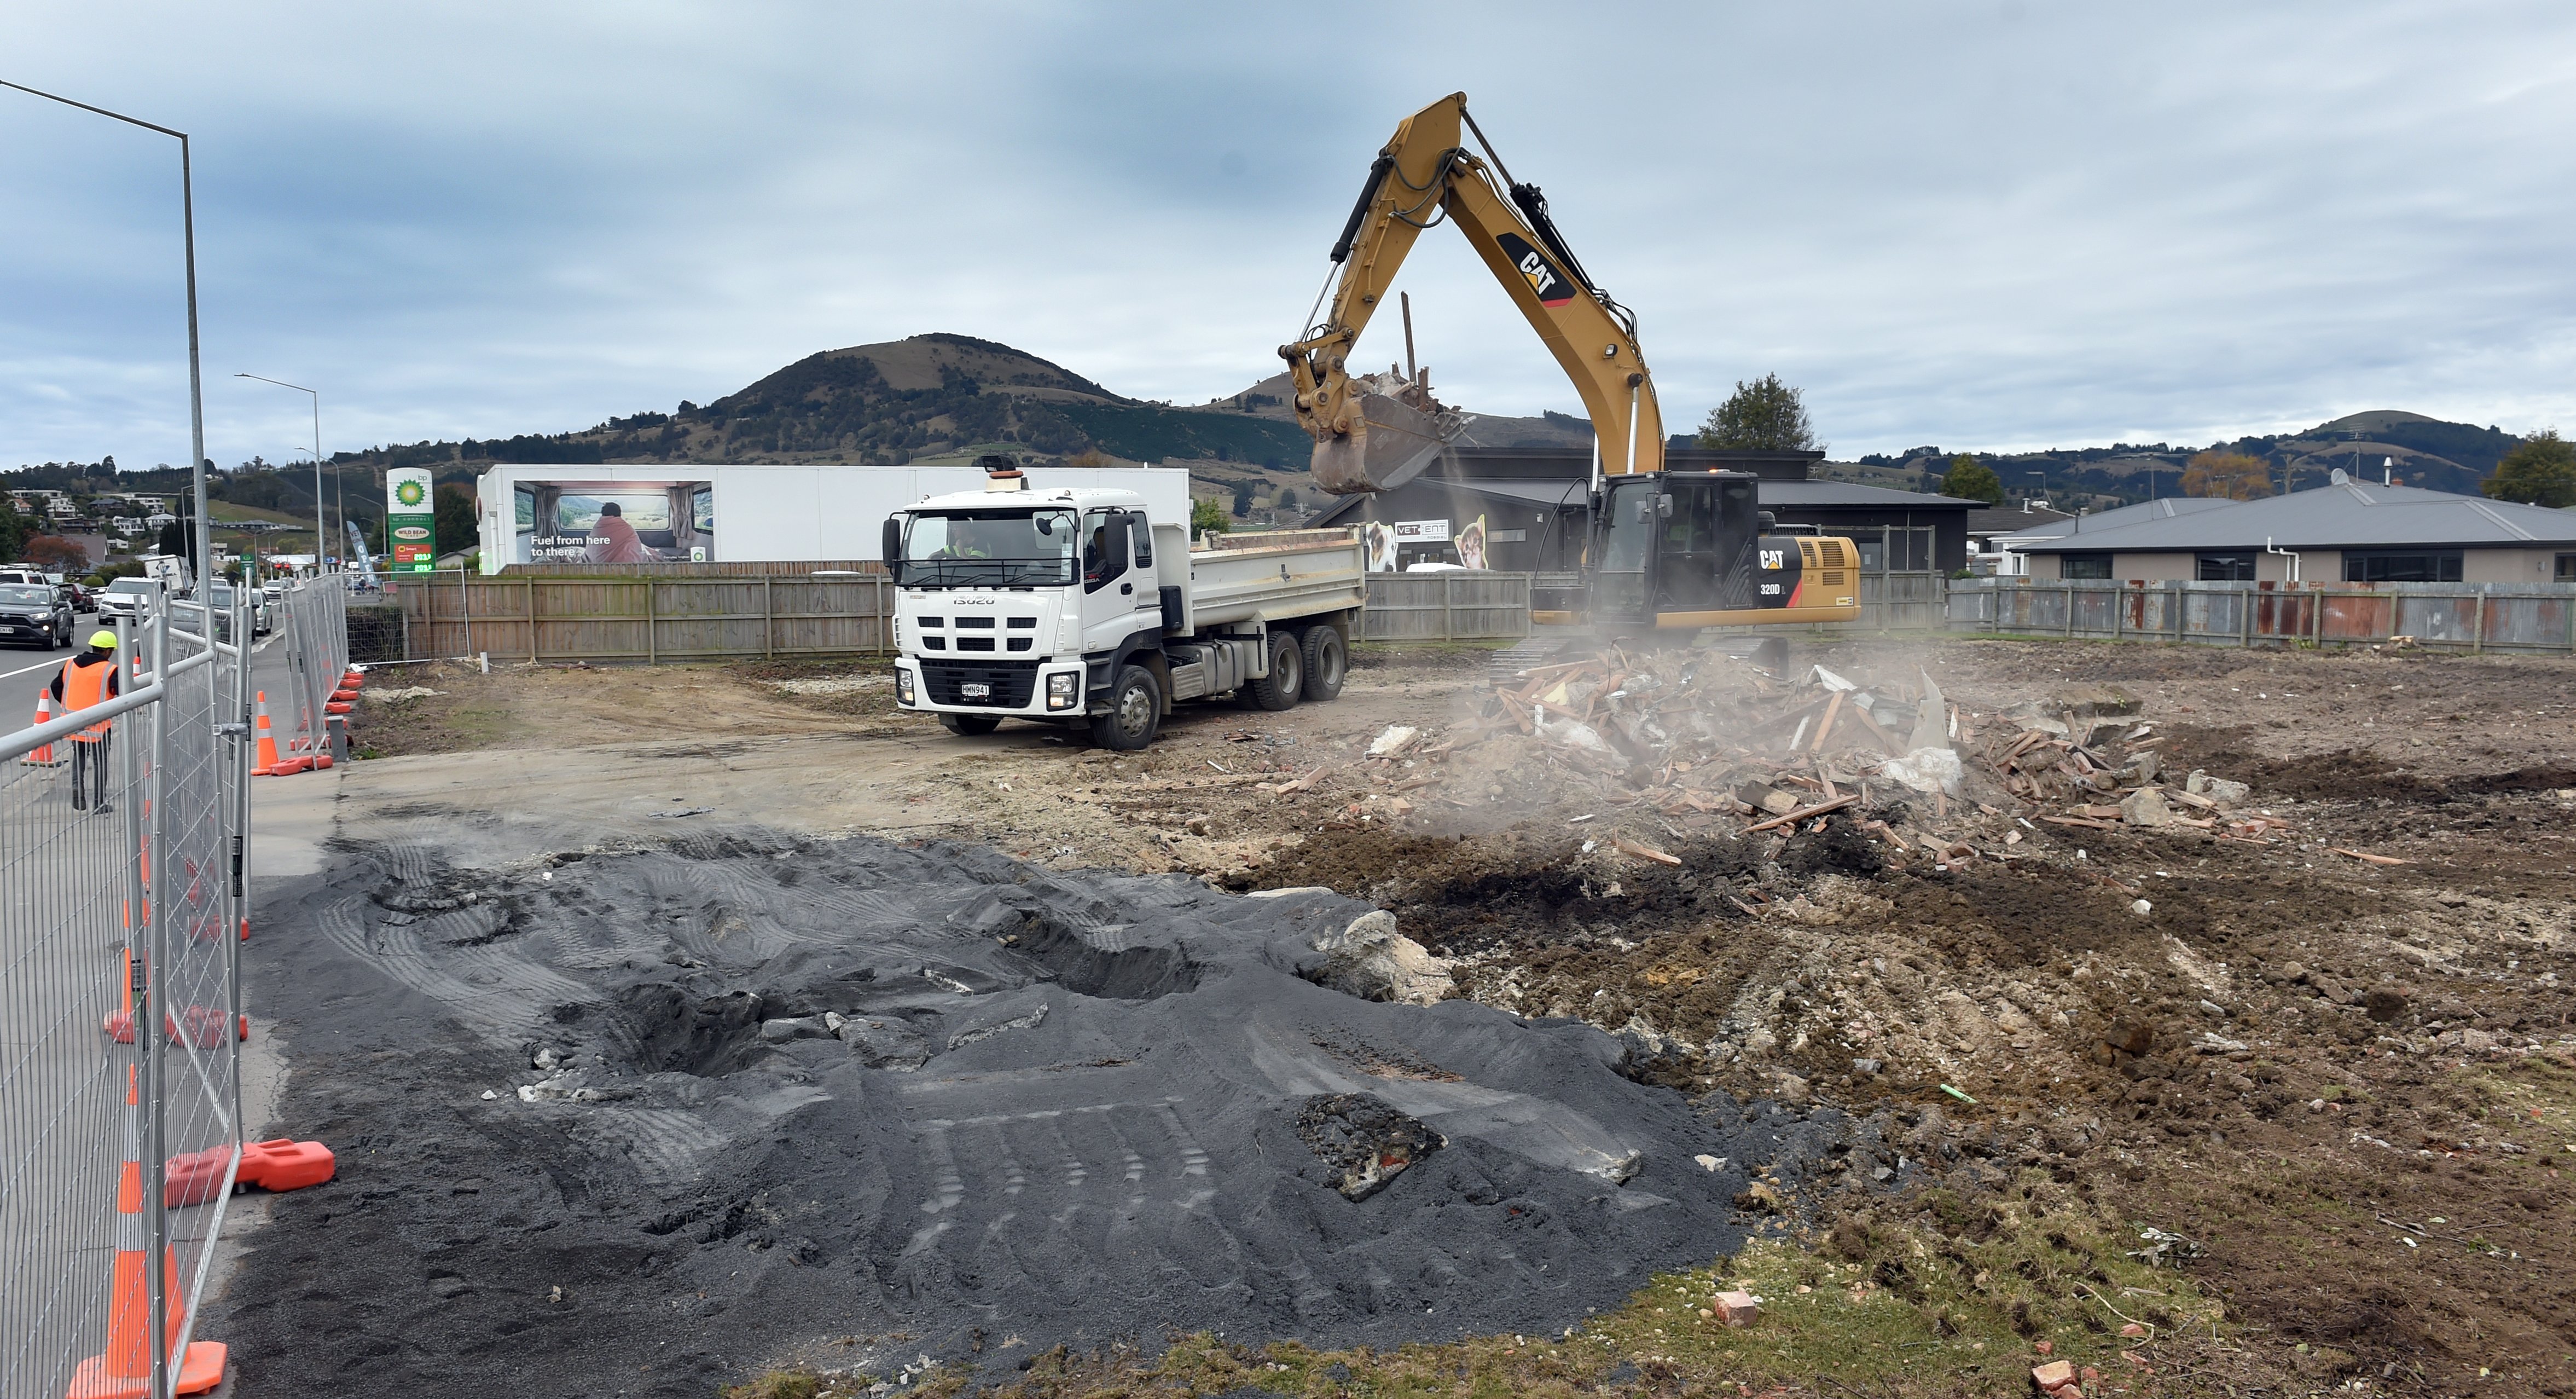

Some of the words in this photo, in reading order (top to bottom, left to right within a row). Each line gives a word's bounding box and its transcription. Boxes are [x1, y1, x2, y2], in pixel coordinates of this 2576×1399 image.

[1520, 252, 1556, 294] CAT
[531, 535, 554, 545] Fuel
[556, 535, 583, 545] from
[585, 535, 611, 545] here
[531, 548, 543, 556] to
[546, 547, 575, 556] there
[358, 545, 374, 582] OPEN
[1760, 550, 1784, 569] CAT
[1760, 584, 1780, 594] 320D
[954, 596, 995, 605] ISUZU
[963, 685, 988, 694] HMN941
